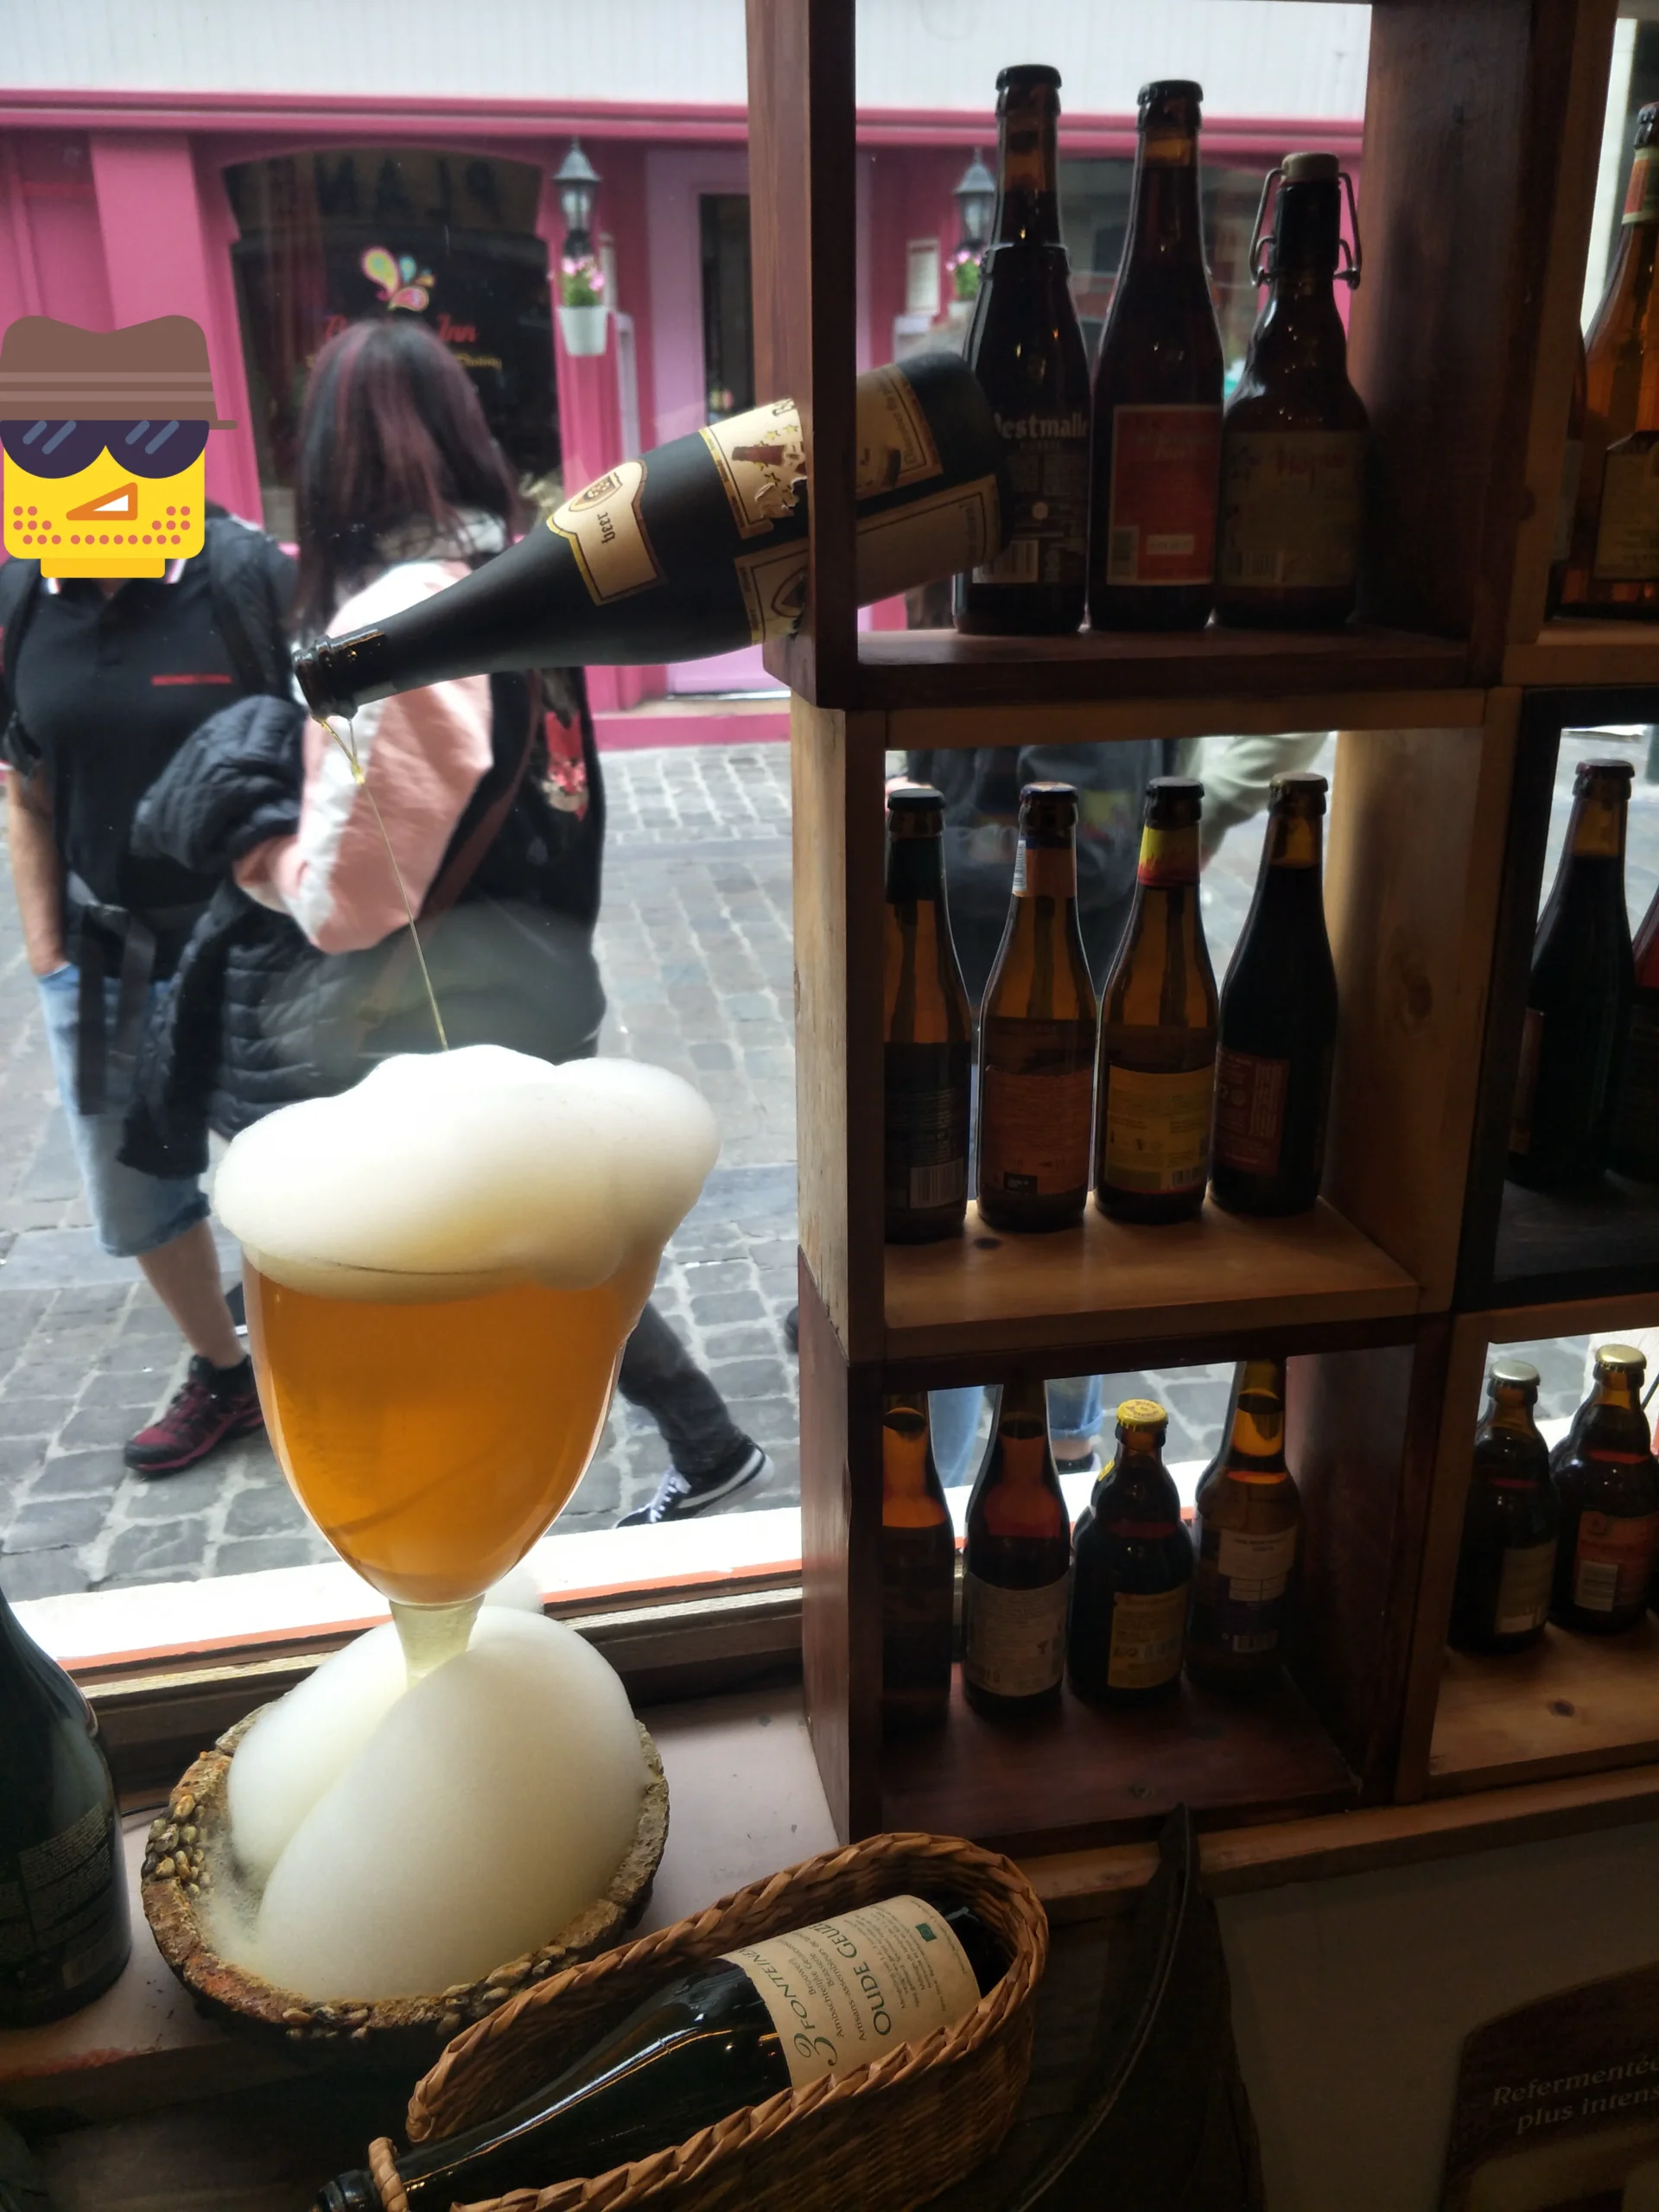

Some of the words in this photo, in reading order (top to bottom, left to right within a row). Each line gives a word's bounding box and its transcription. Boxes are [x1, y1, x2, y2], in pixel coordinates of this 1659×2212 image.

[596, 512, 615, 545] beer
[809, 1952, 836, 1987] Brasserie
[852, 1961, 891, 2036] OUDE
[792, 2032, 837, 2068] 3
[1515, 2101, 1573, 2136] plus
